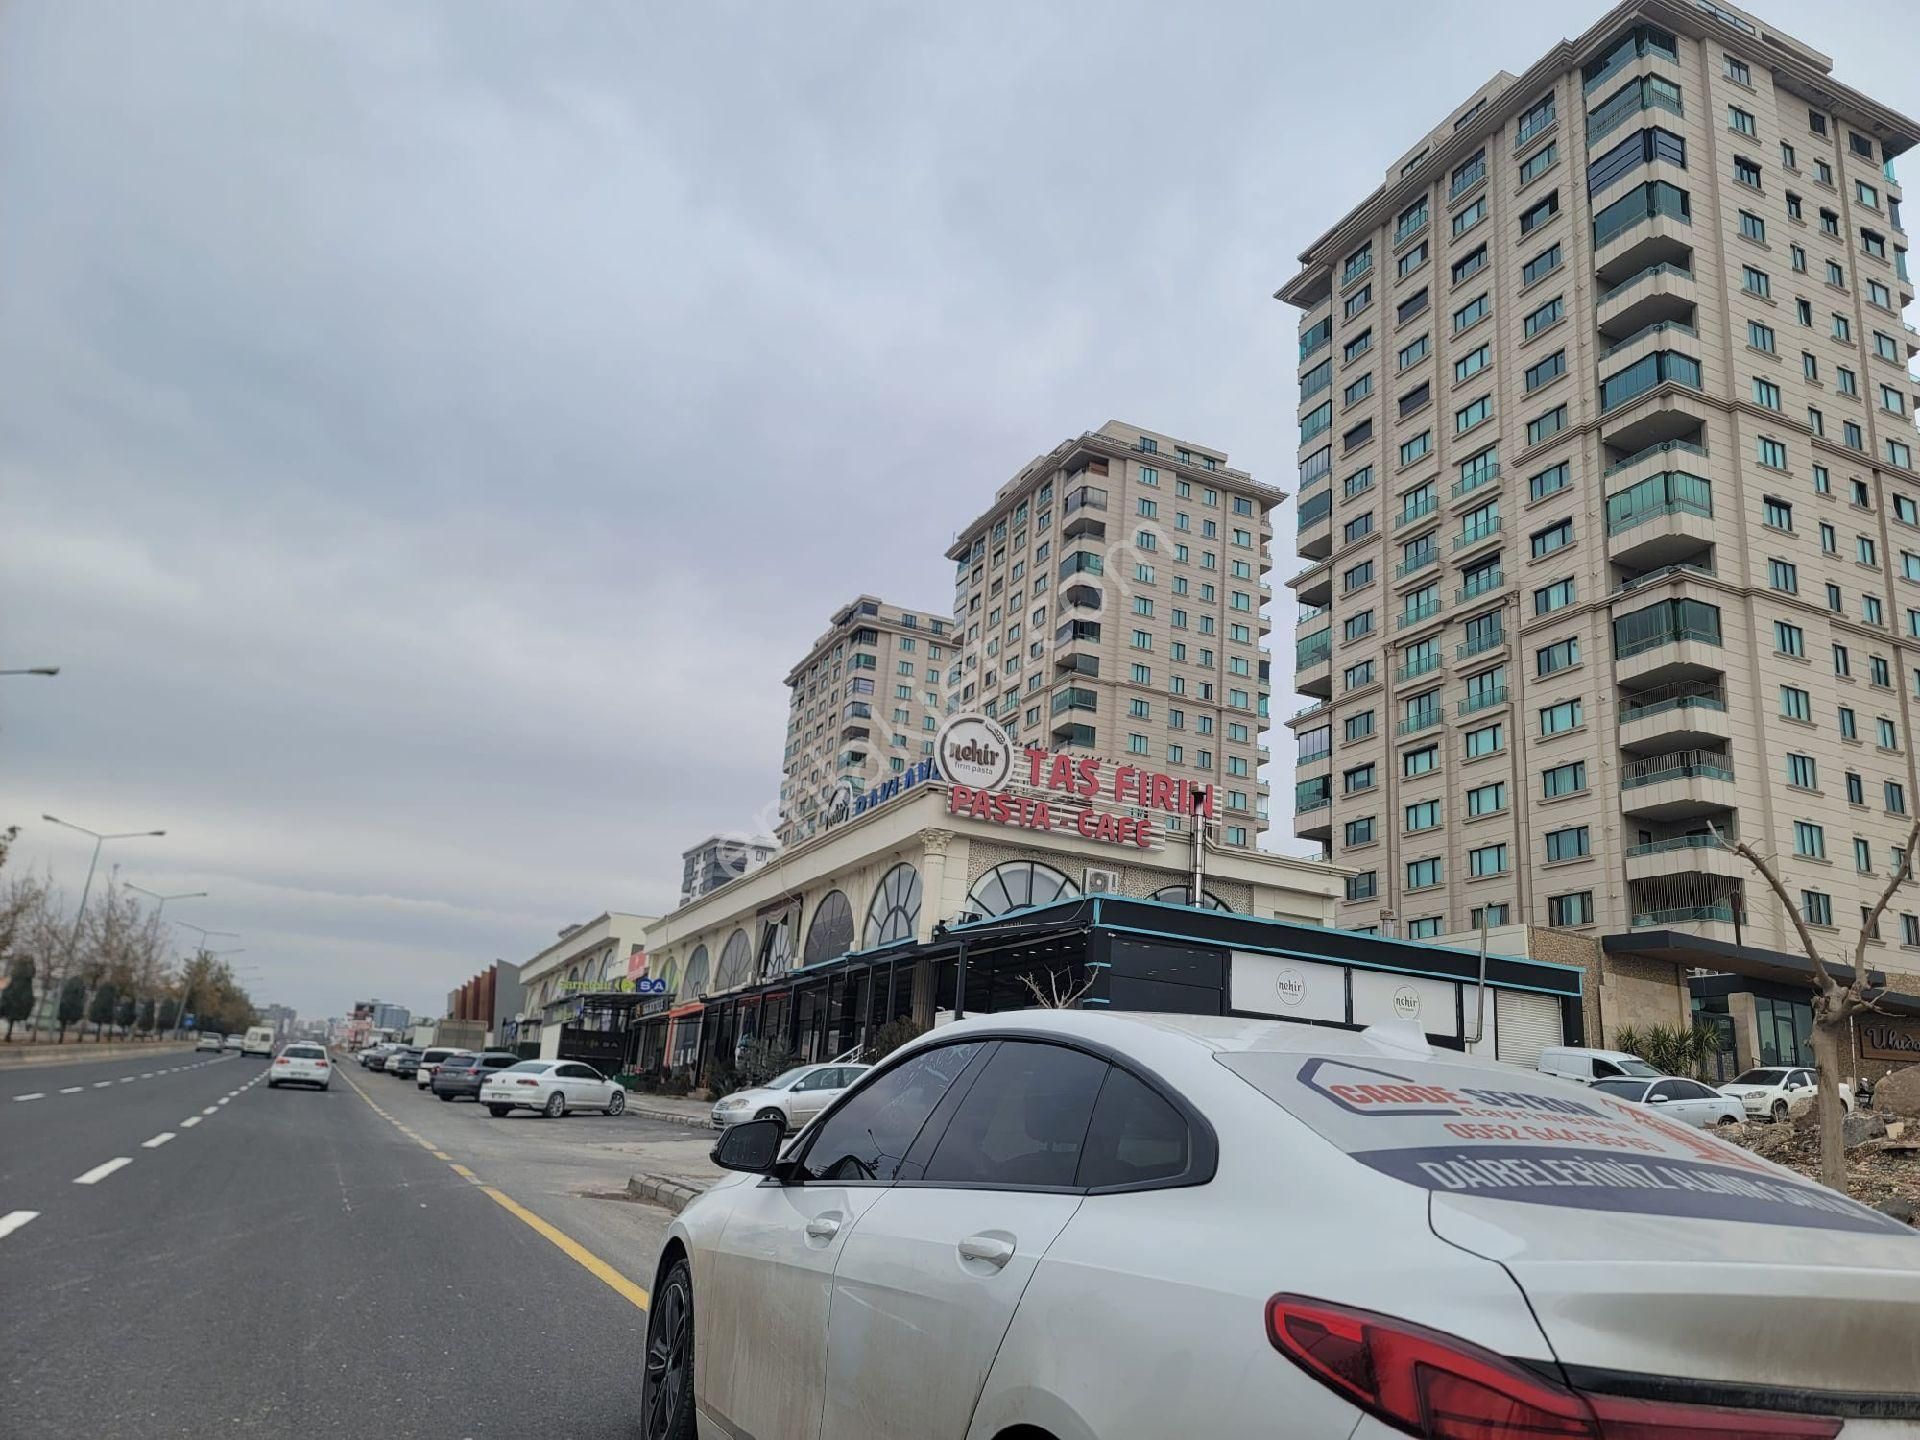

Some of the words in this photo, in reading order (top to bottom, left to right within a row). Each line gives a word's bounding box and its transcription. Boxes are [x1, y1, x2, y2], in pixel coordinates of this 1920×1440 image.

[949, 739, 999, 766] nehir
[971, 765, 993, 775] pasta
[1114, 766, 1214, 819] FIRIN
[950, 785, 1051, 830] PASTA
[1078, 809, 1152, 848] CAFE
[640, 981, 665, 991] SA
[1278, 978, 1303, 992] nehir
[1443, 1124, 1530, 1140] 0552
[1522, 1126, 1588, 1143] 644
